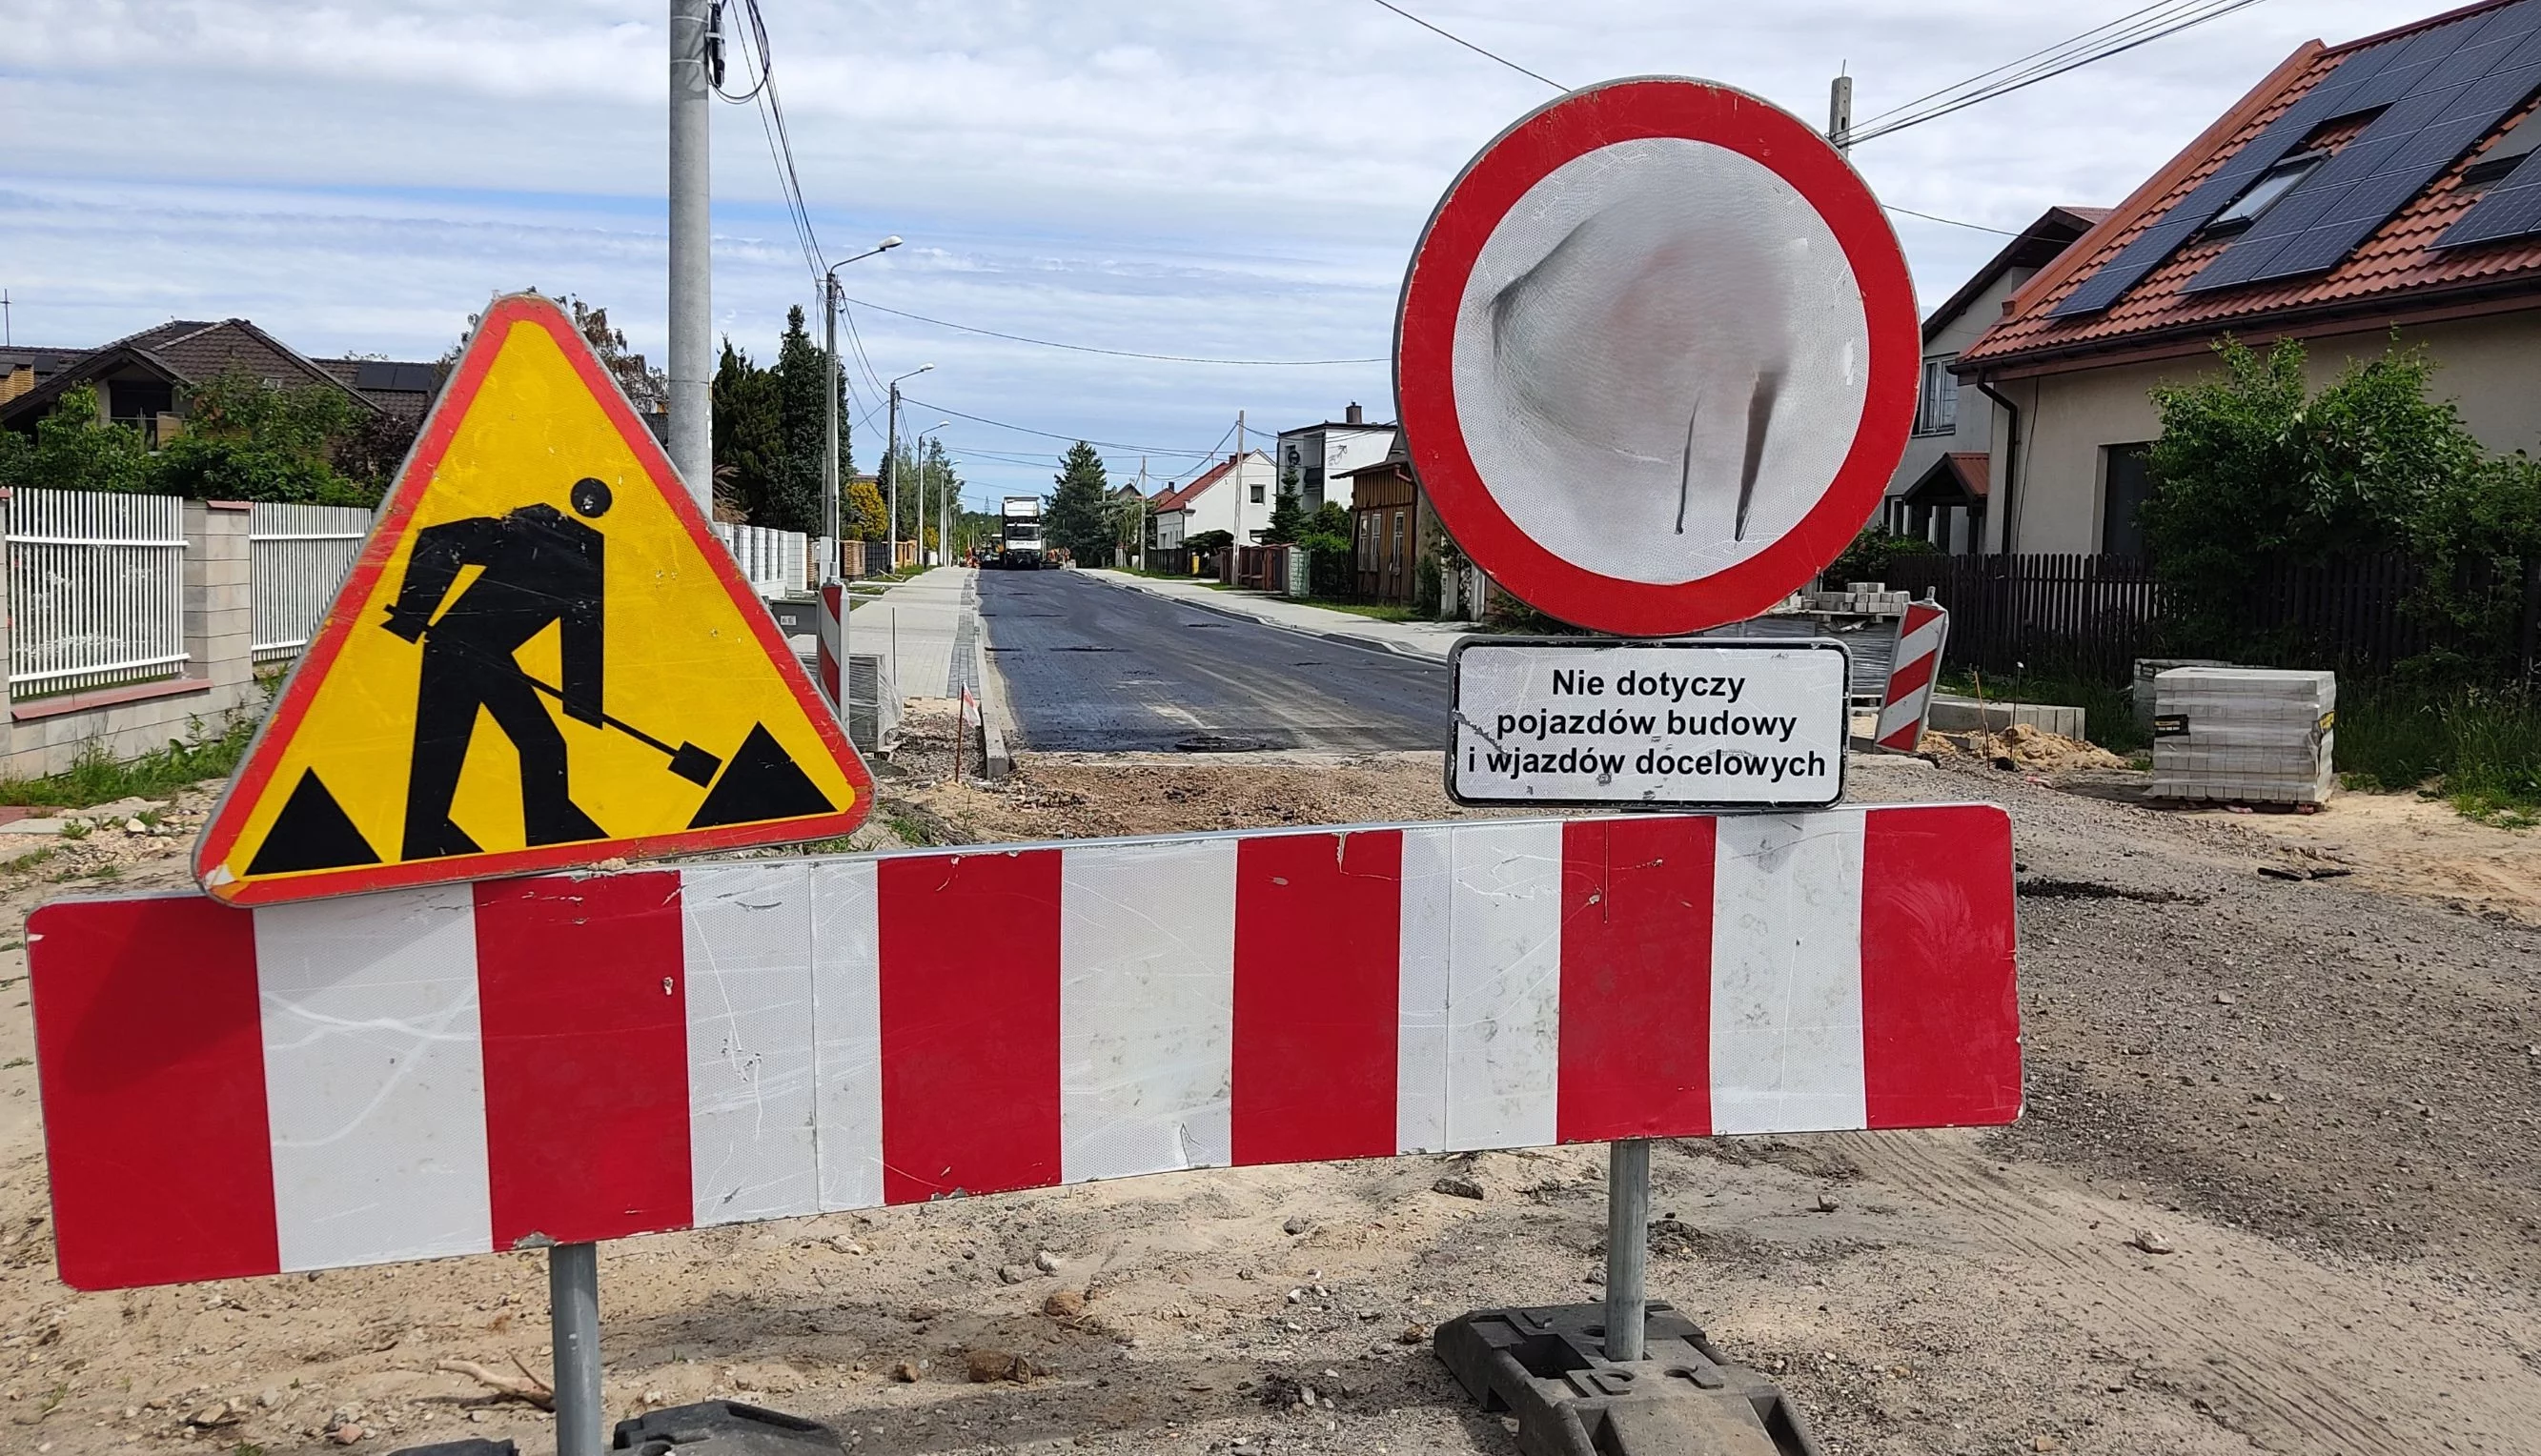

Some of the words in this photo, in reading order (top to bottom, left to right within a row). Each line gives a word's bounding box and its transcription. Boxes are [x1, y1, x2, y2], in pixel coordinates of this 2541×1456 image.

[1553, 669, 1605, 696] Nie
[1616, 669, 1746, 703] dotyczy
[1497, 708, 1657, 740] pojazdów
[1667, 709, 1798, 743] budowy
[1468, 746, 1475, 773] i
[1486, 747, 1626, 779] wjazdów
[1635, 748, 1825, 782] docelowych
